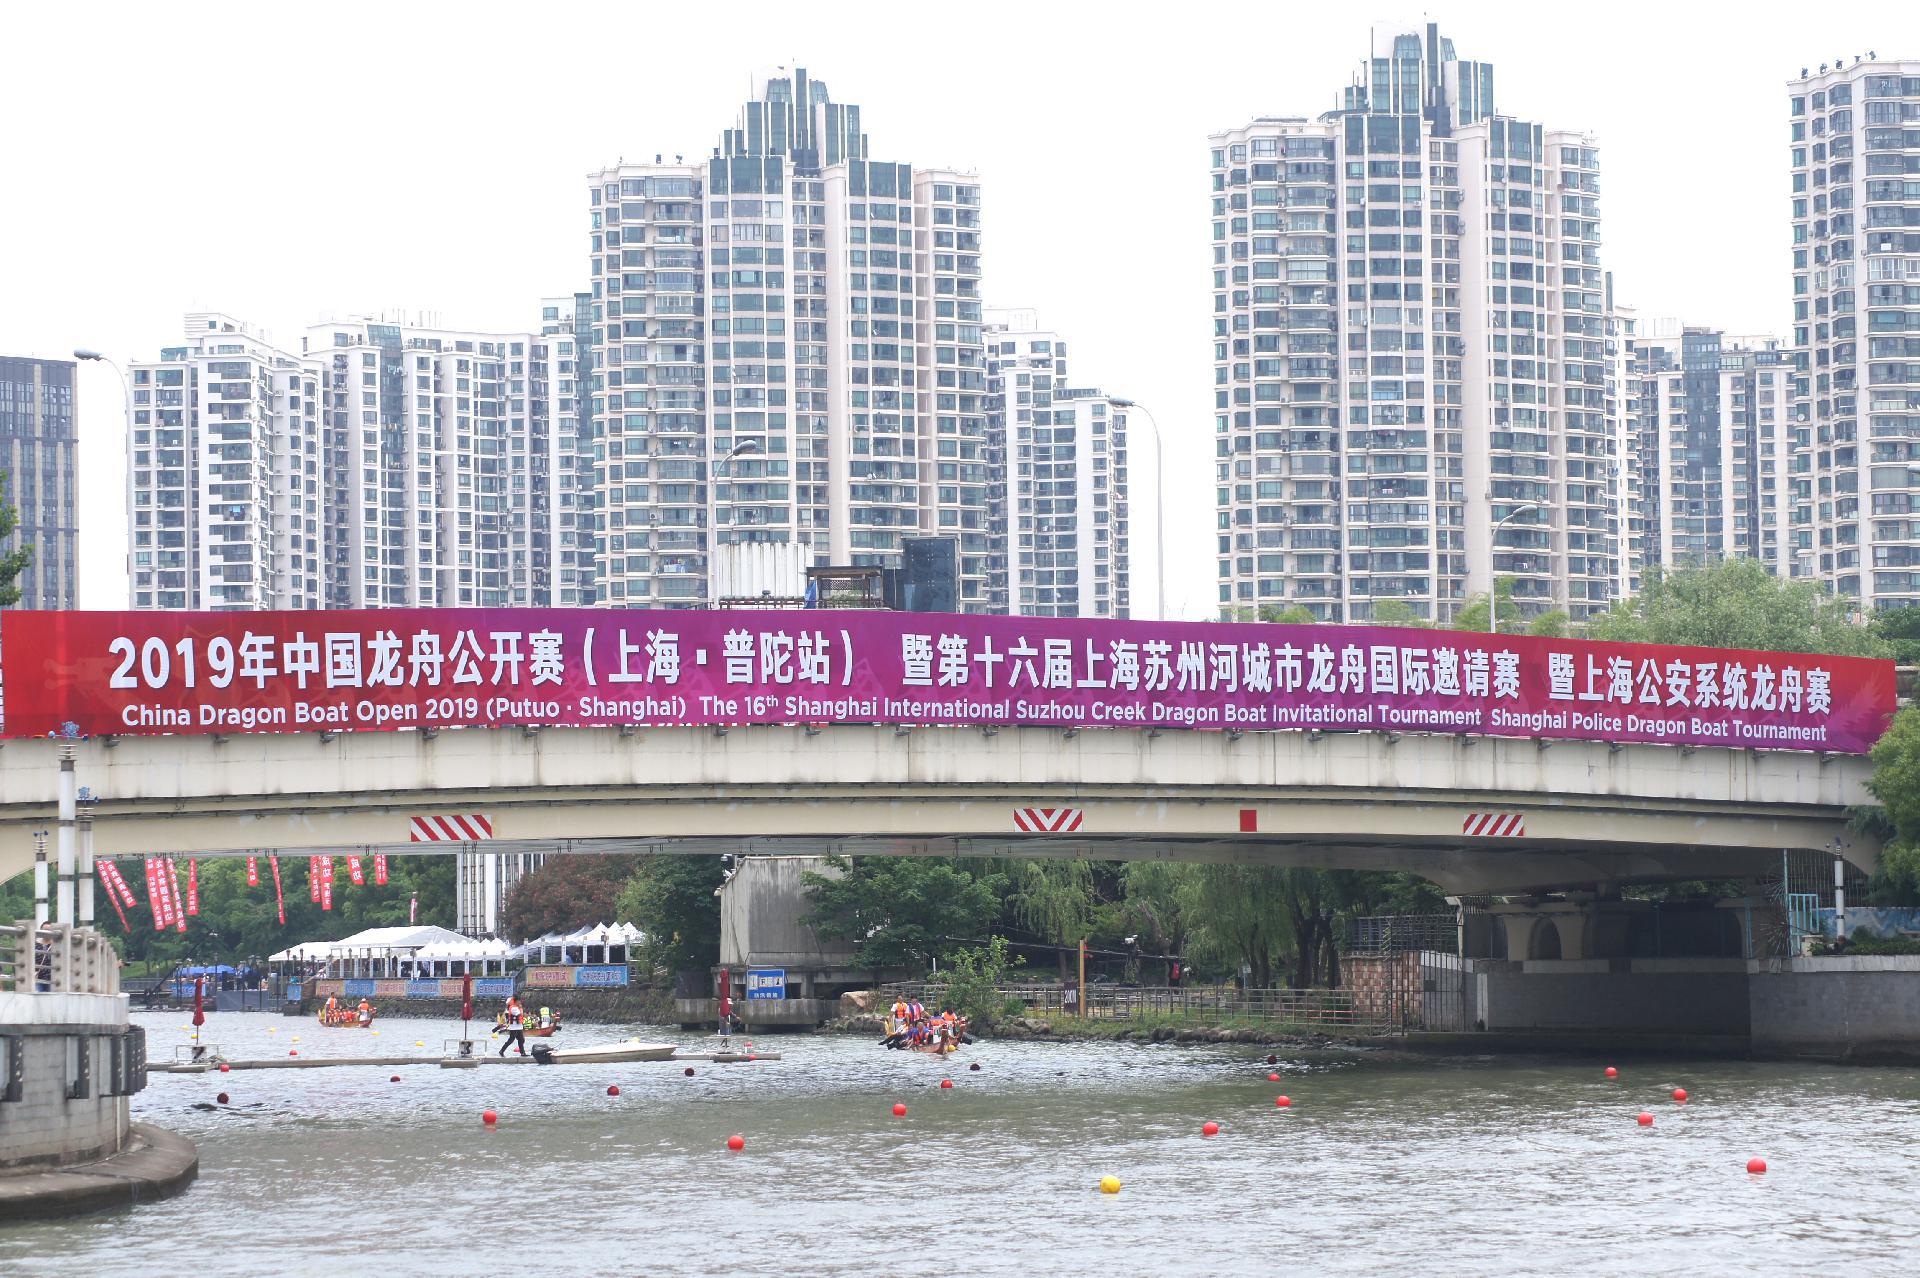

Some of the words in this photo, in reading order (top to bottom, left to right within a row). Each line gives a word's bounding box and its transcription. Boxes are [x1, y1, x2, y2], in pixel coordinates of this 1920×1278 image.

[901, 633, 1521, 700] 暨第十六届上海苏州河城市龙舟国际邀请赛
[1548, 652, 1832, 715] 暨上海公安系统龙舟赛
[121, 703, 191, 727] China
[200, 704, 285, 730] Dragon
[295, 702, 349, 724] Boat
[356, 700, 418, 728] Open
[425, 698, 478, 721] 2019
[486, 698, 560, 722] (Putuo
[579, 695, 687, 722] Shanghai)
[699, 696, 738, 716] The
[744, 694, 779, 717] 16th
[784, 696, 878, 723] Shanghai
[884, 697, 1010, 720] International
[1016, 699, 1085, 721] Suzhou
[1091, 700, 1147, 722] Creek
[1152, 701, 1219, 726] Dragon
[1224, 703, 1267, 724] Boat
[1272, 703, 1373, 725] Invitational
[1377, 704, 1482, 727] Tournament
[1491, 708, 1567, 733] Shanghai
[1572, 711, 1622, 733] Police
[1627, 714, 1686, 738] Dragon
[1691, 717, 1729, 738] Boat
[1733, 719, 1827, 742] Tournament
